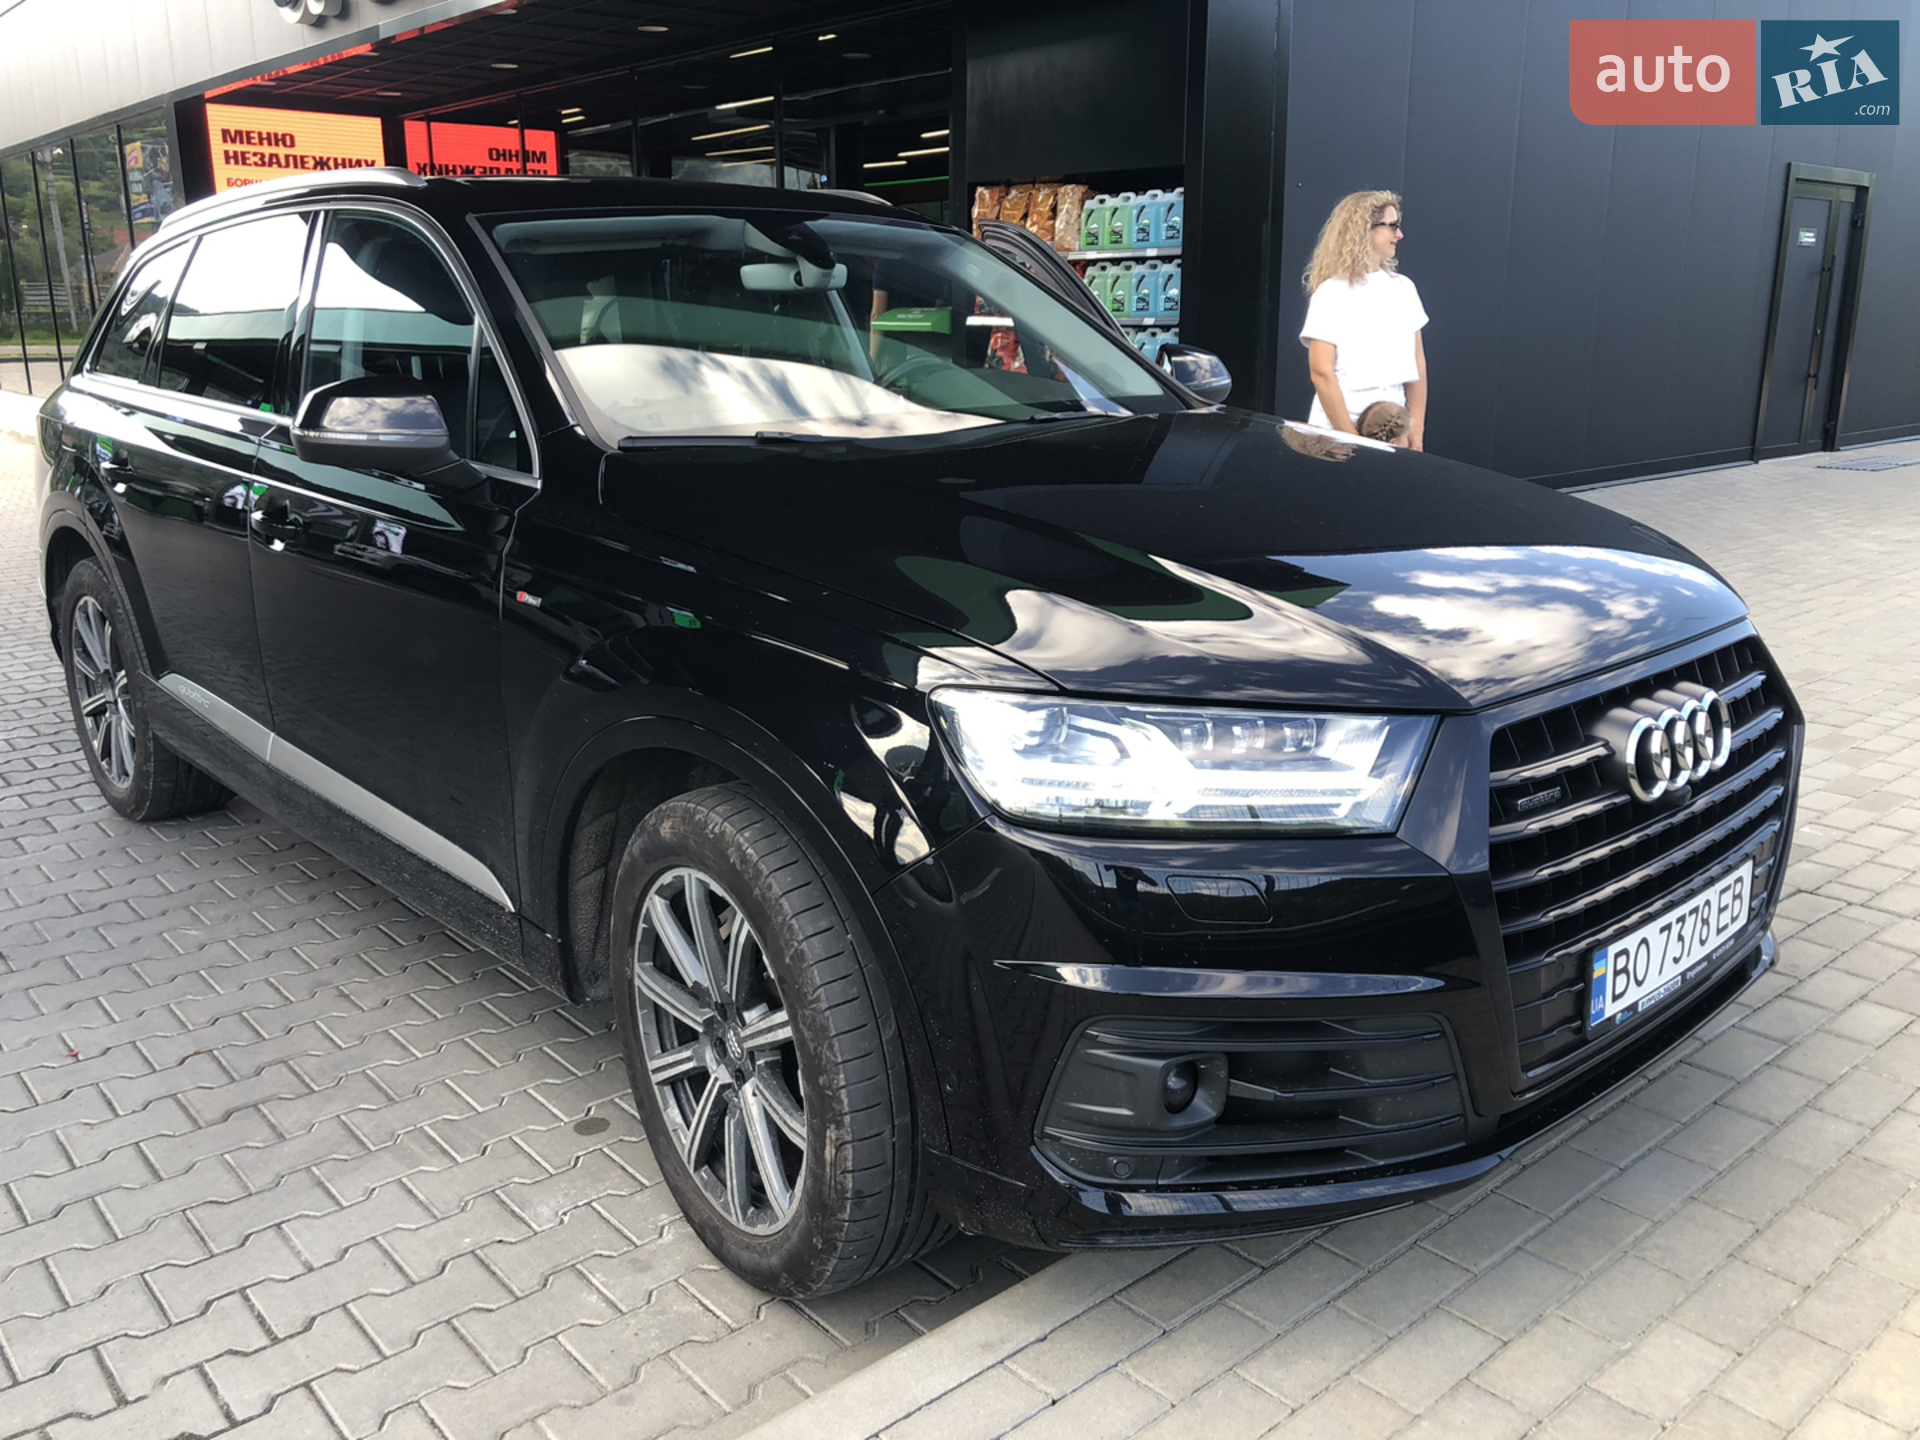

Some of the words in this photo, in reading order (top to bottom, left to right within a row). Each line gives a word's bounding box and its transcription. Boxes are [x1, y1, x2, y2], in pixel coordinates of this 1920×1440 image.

[221, 128, 296, 148] МЕНЮ
[1612, 937, 1650, 1004] BO
[1658, 899, 1711, 976] 7378
[1716, 875, 1744, 937] EB
[1591, 995, 1604, 1014] UA
